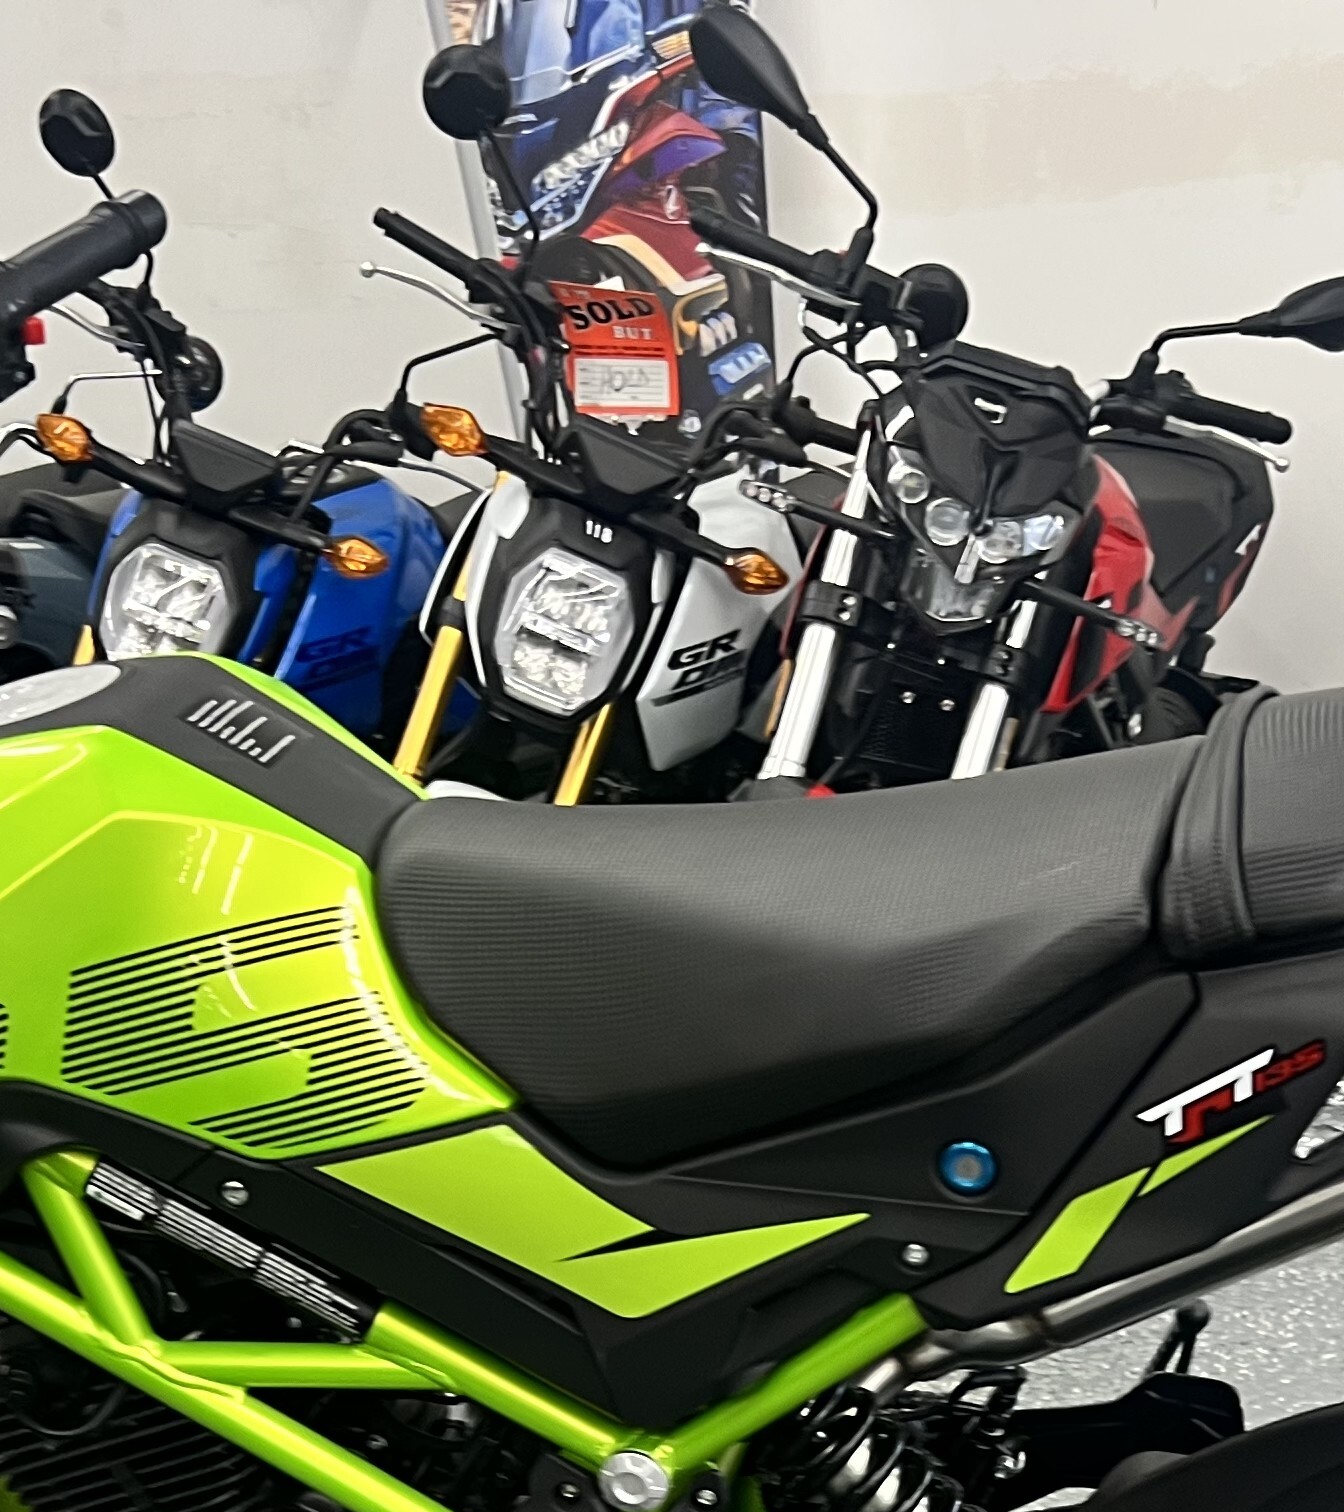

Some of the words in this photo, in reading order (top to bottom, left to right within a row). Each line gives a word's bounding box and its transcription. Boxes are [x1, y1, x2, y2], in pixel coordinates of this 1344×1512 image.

[564, 297, 655, 330] SOLD
[612, 326, 653, 340] BUT
[667, 628, 742, 671] GR
